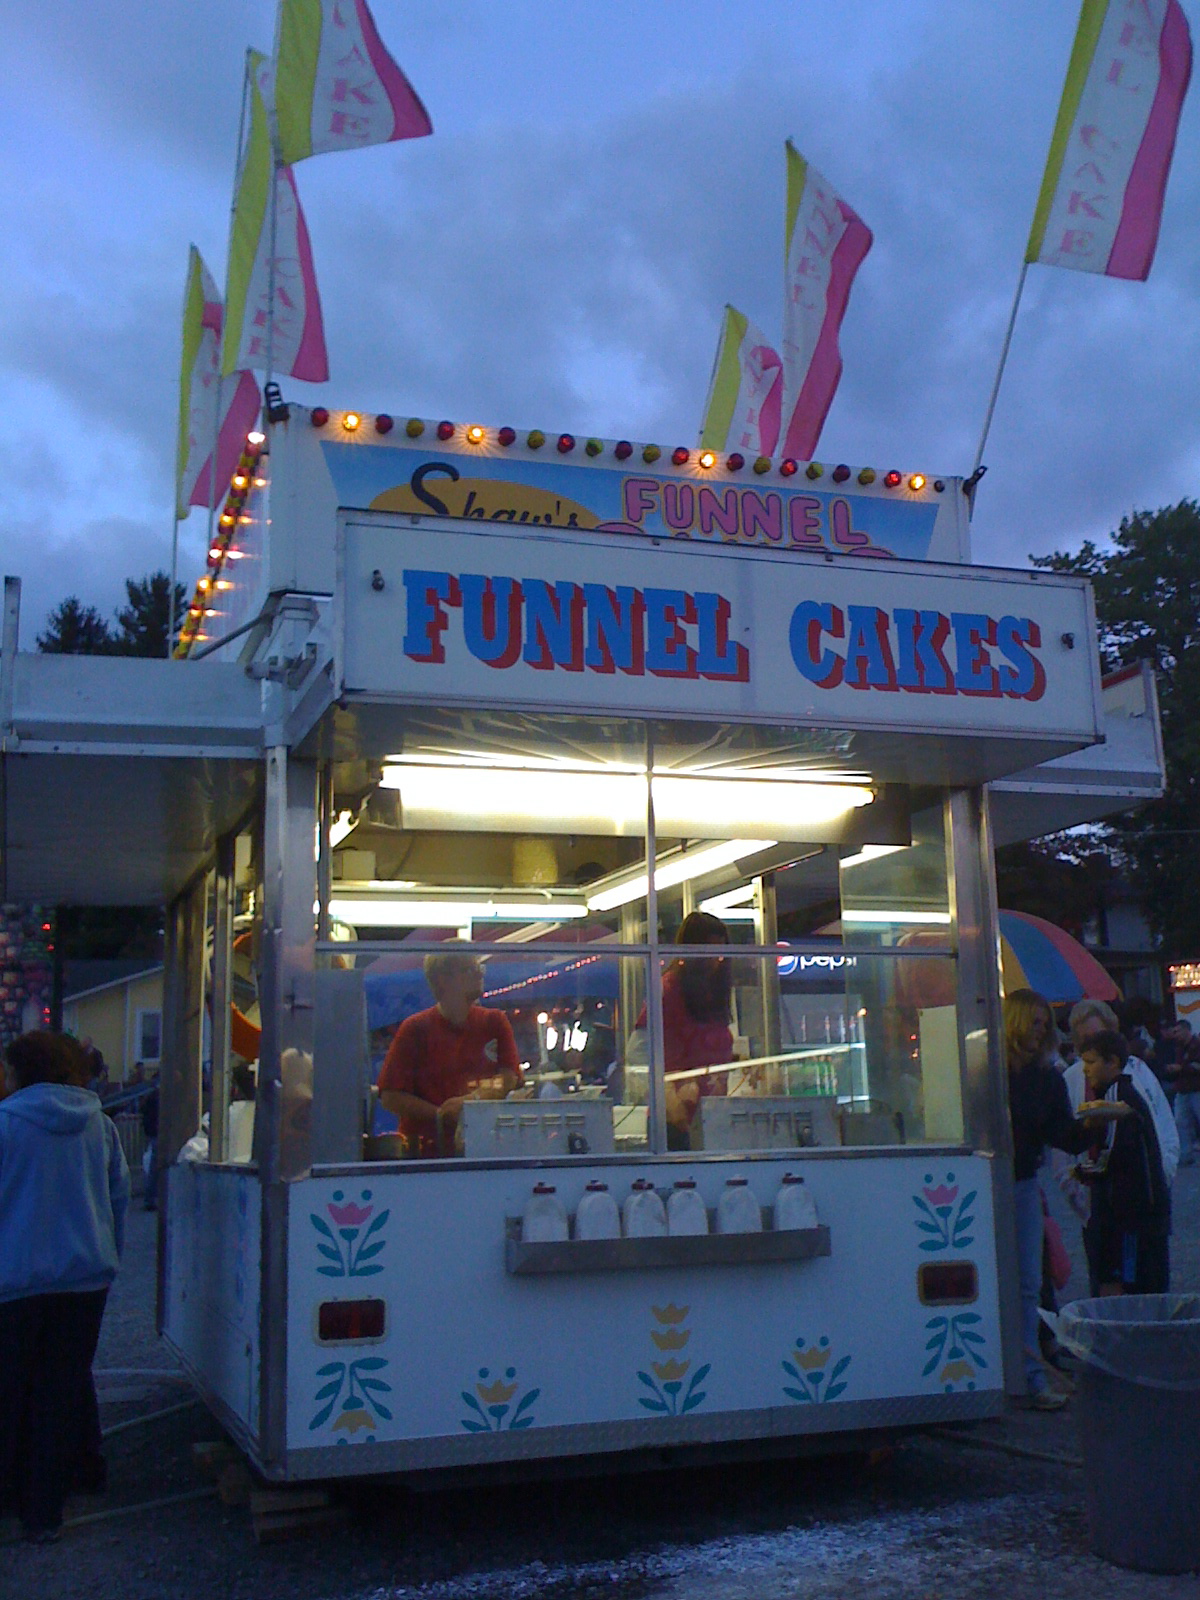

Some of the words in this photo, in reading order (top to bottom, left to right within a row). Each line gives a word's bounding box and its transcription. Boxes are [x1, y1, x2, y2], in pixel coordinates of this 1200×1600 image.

[624, 477, 870, 546] FUNNEL
[402, 569, 750, 682] FUNNEL
[788, 600, 1047, 702] CAKES
